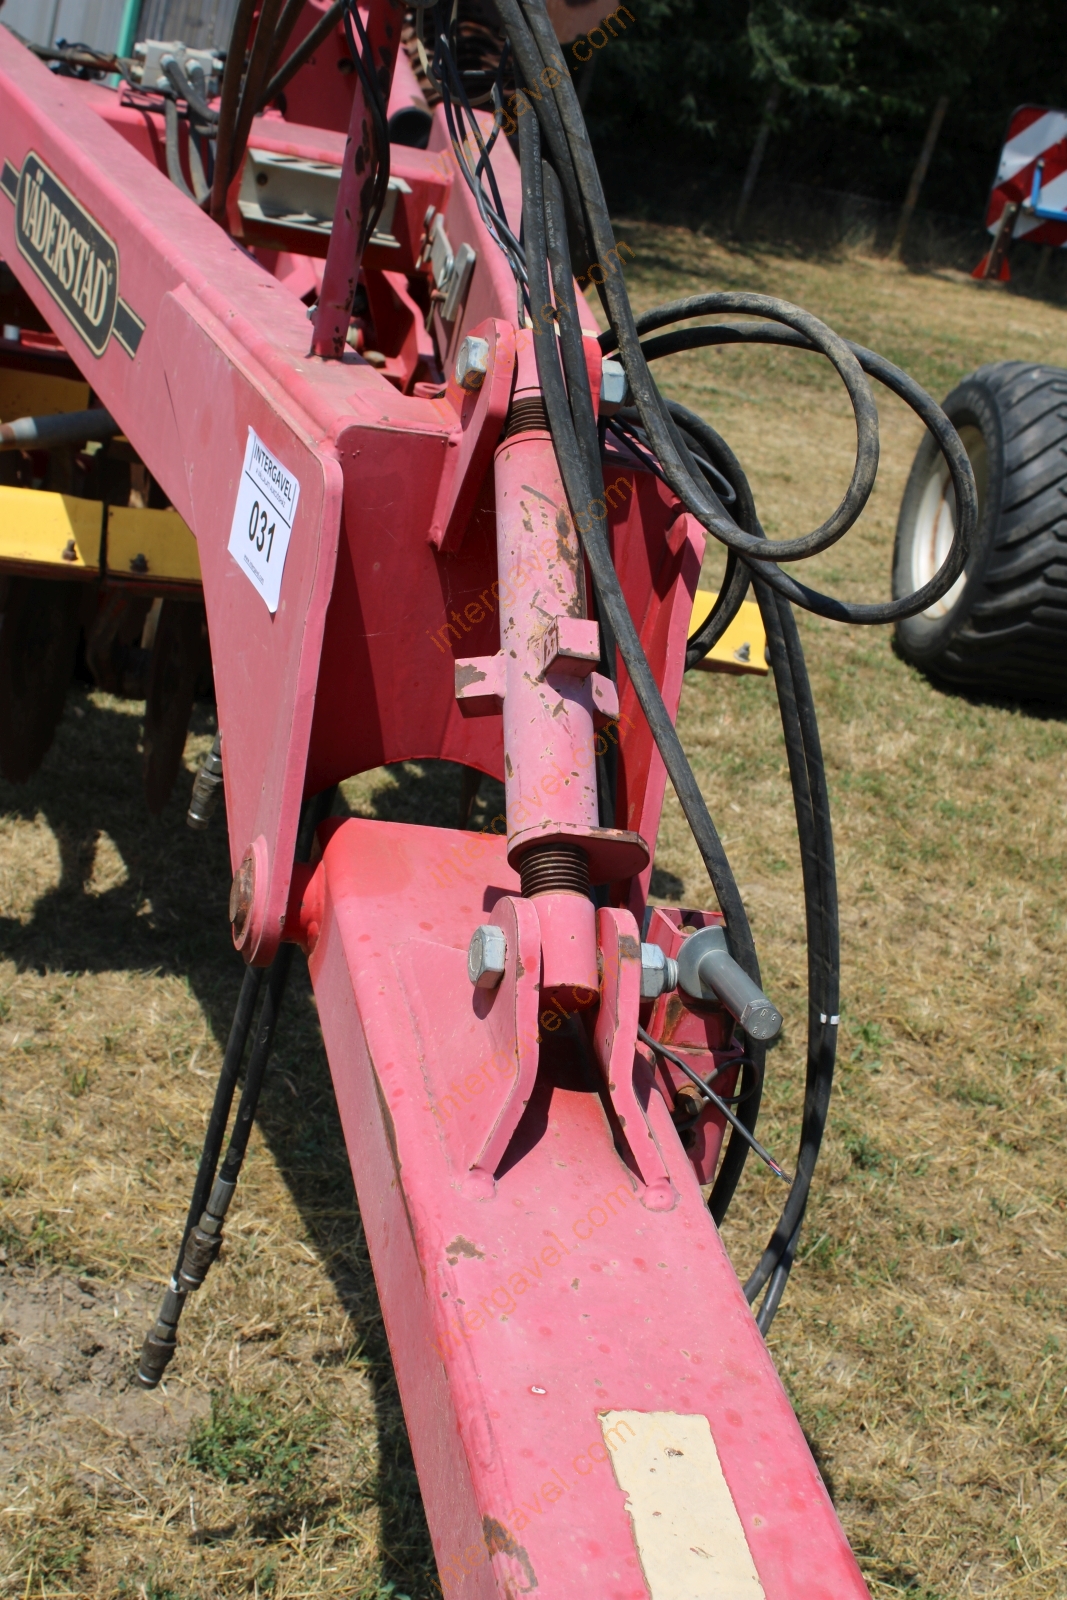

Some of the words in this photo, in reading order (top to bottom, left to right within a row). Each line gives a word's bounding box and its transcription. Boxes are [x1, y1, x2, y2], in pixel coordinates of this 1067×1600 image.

[22, 168, 109, 327] VÄDERSTAD
[253, 443, 292, 501] INTERGAVEL
[248, 500, 276, 563] 031
